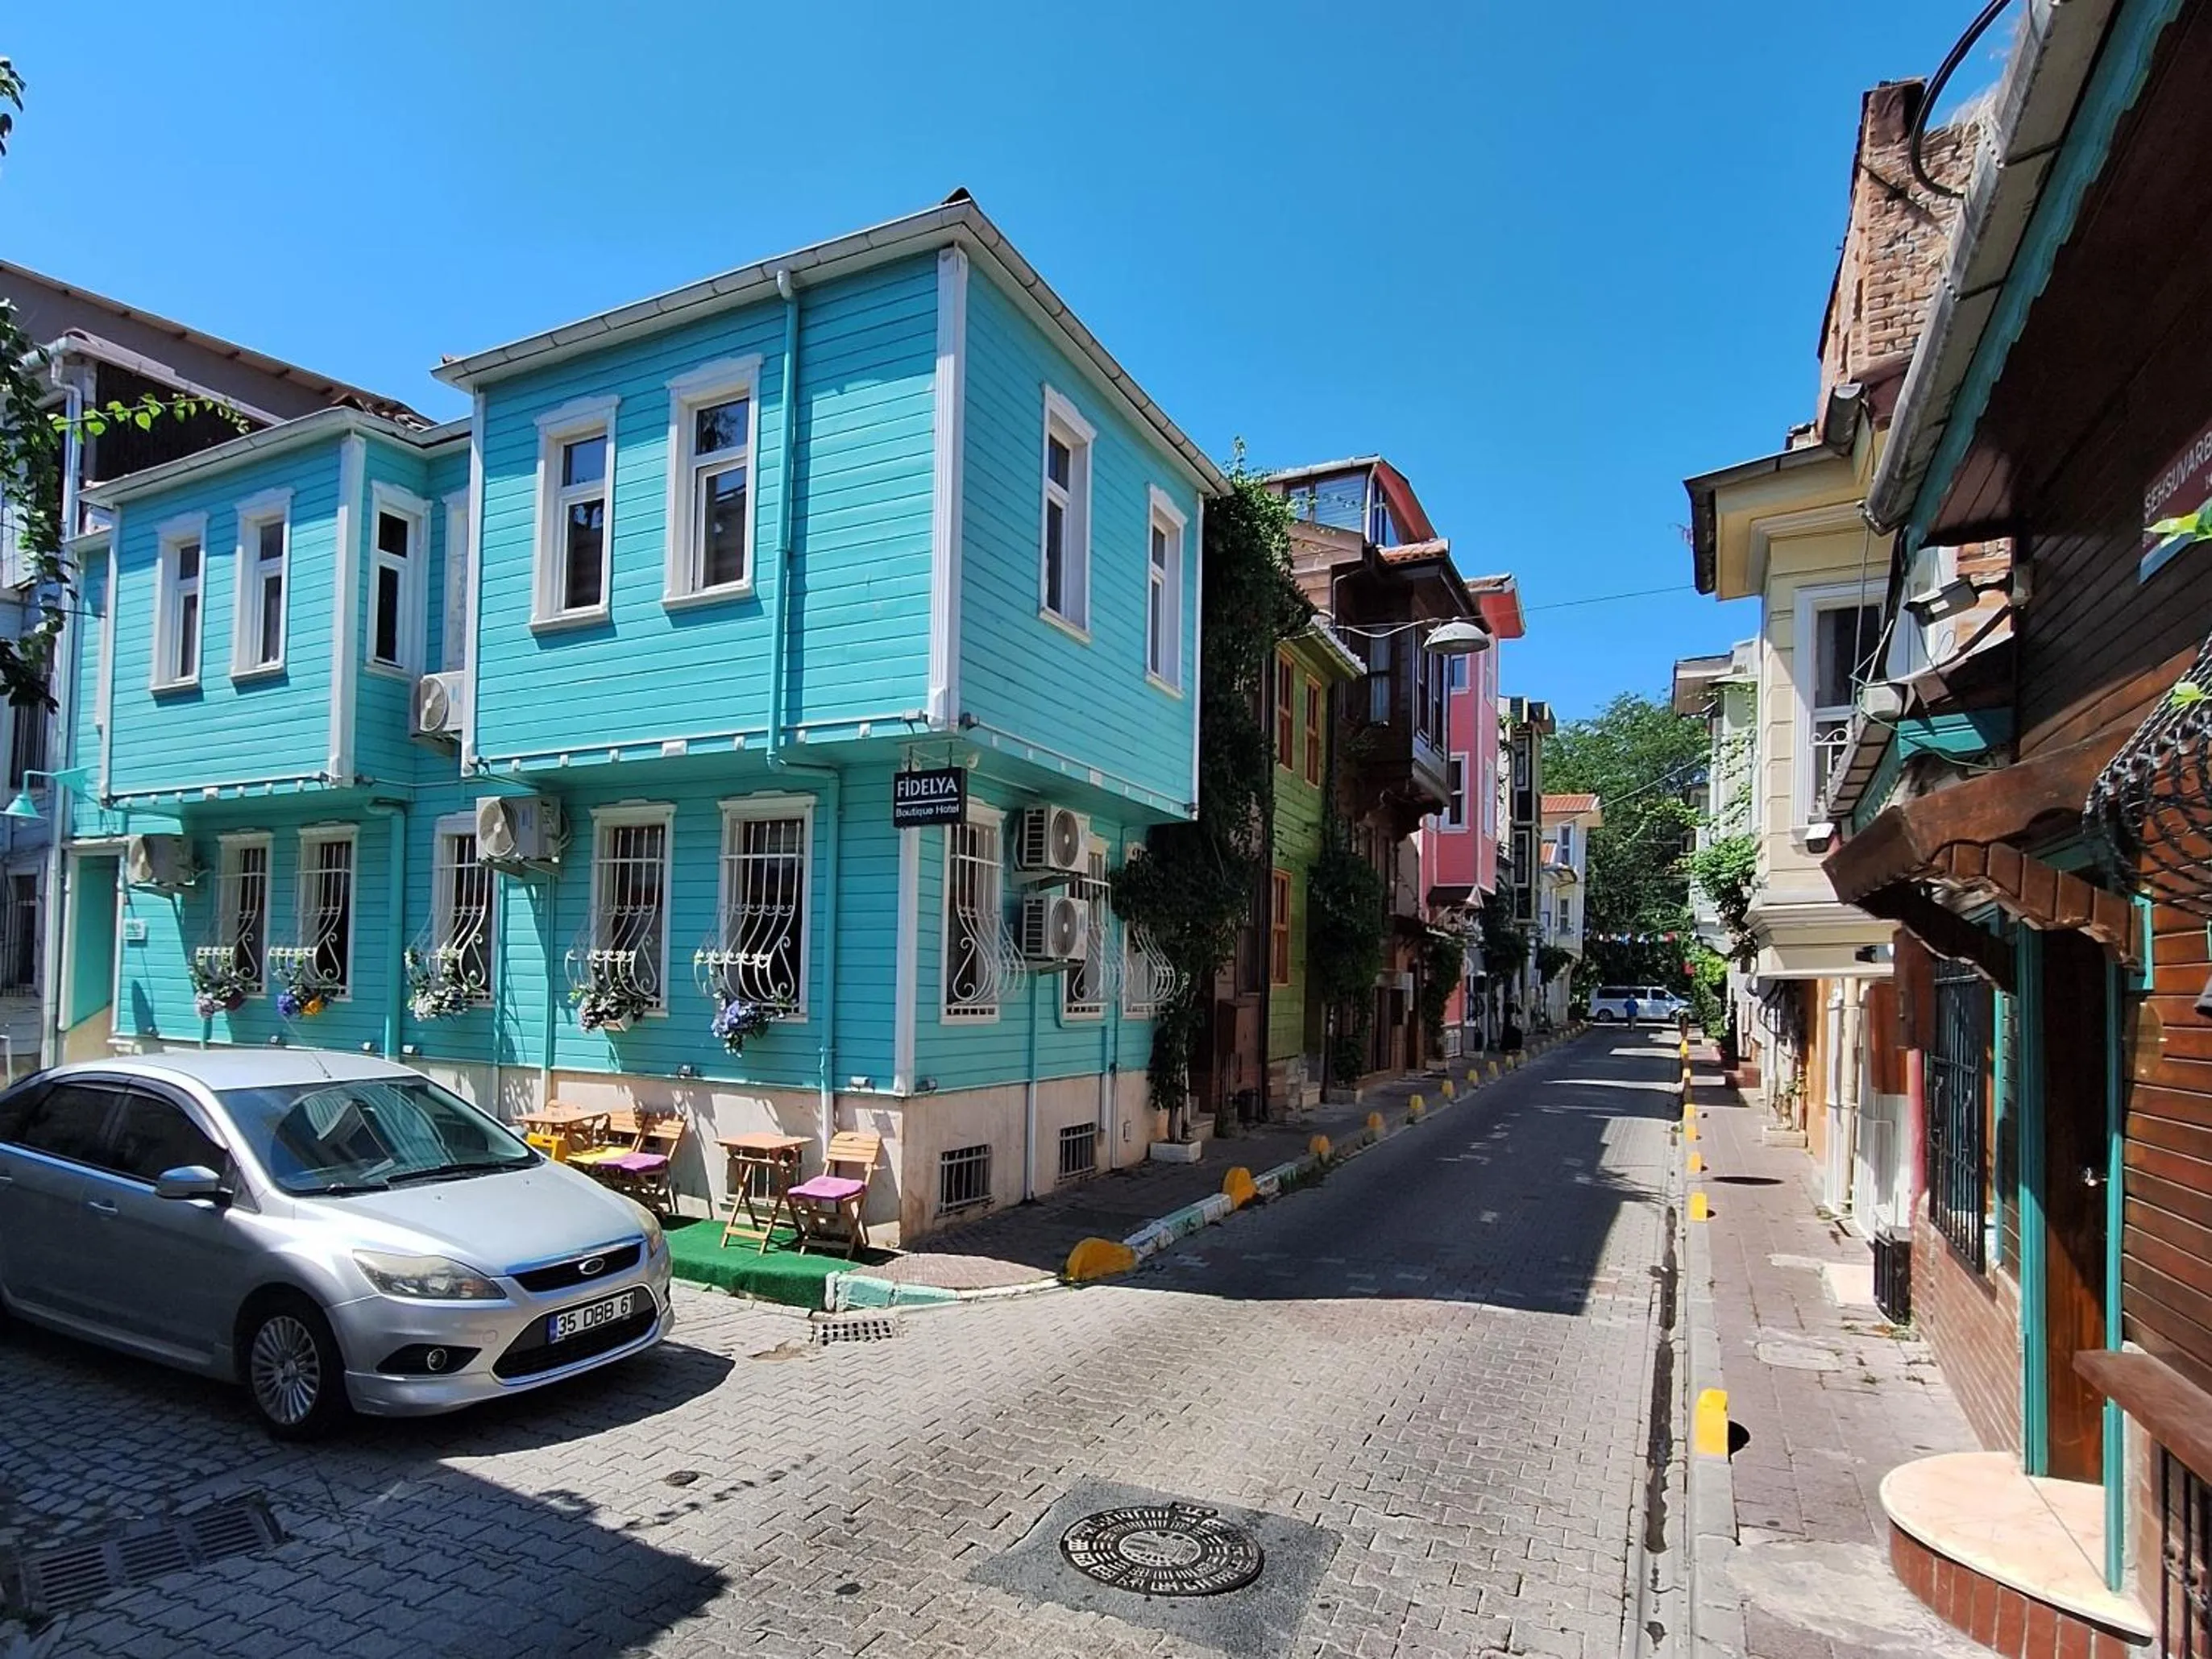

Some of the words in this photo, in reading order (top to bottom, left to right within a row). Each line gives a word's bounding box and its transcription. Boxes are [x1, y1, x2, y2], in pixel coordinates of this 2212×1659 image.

[895, 807, 934, 818] Boutique
[936, 803, 959, 814] Hotel
[558, 1313, 576, 1335] 35
